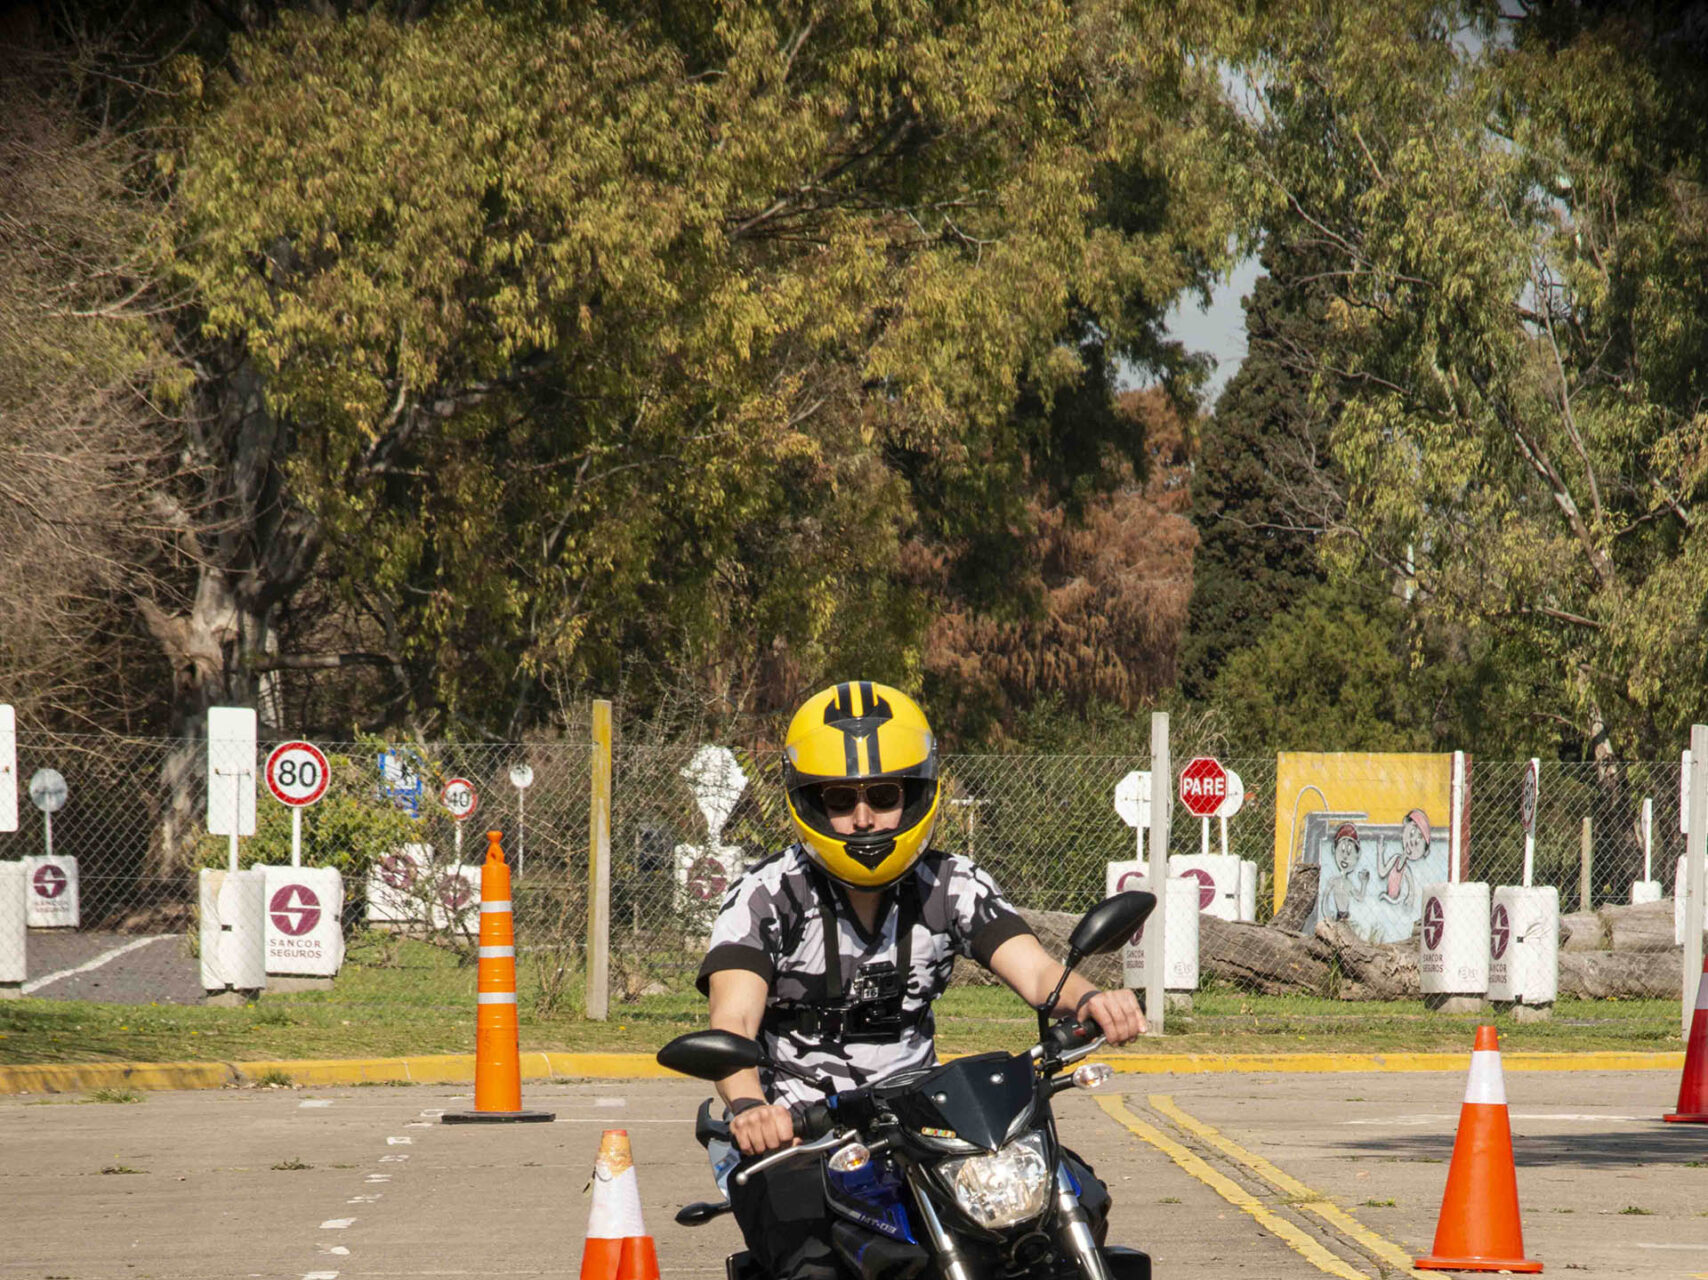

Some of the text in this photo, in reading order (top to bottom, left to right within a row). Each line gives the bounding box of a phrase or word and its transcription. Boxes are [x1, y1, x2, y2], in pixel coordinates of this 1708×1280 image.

[279, 760, 316, 787] 80
[1184, 777, 1225, 796] PARE
[447, 791, 470, 807] 40
[270, 939, 321, 948] SANCOR
[270, 949, 322, 959] SEGUROS
[861, 1215, 897, 1235] MT-03
